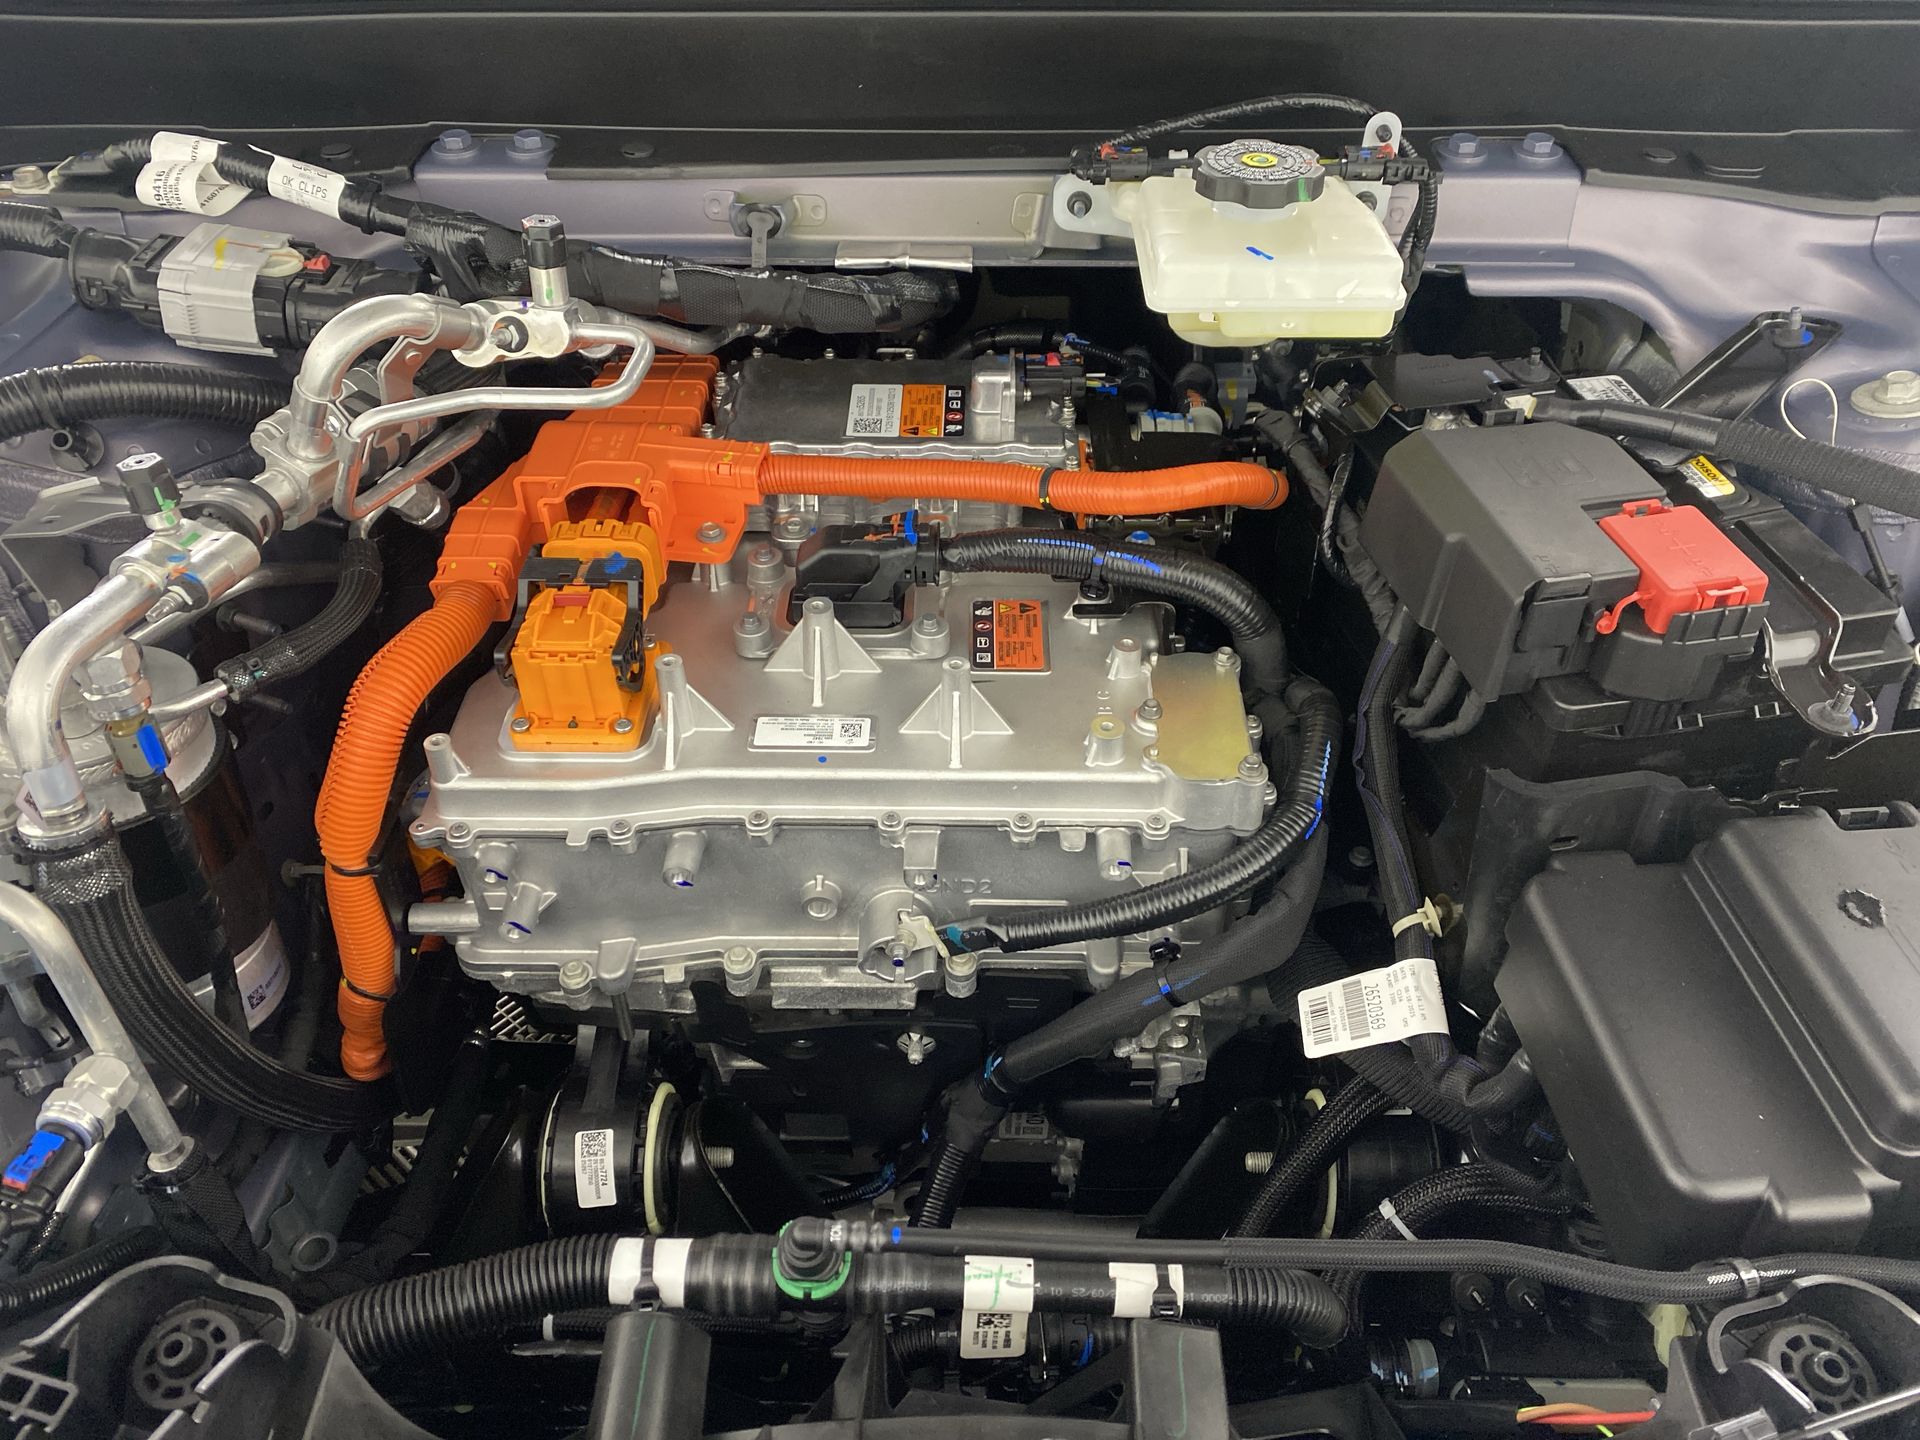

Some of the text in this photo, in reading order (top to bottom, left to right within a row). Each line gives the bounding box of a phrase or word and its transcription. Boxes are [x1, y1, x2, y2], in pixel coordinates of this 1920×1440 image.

[281, 175, 294, 188] OK
[298, 180, 328, 199] CLIPS
[1364, 983, 1387, 1030] 26520369
